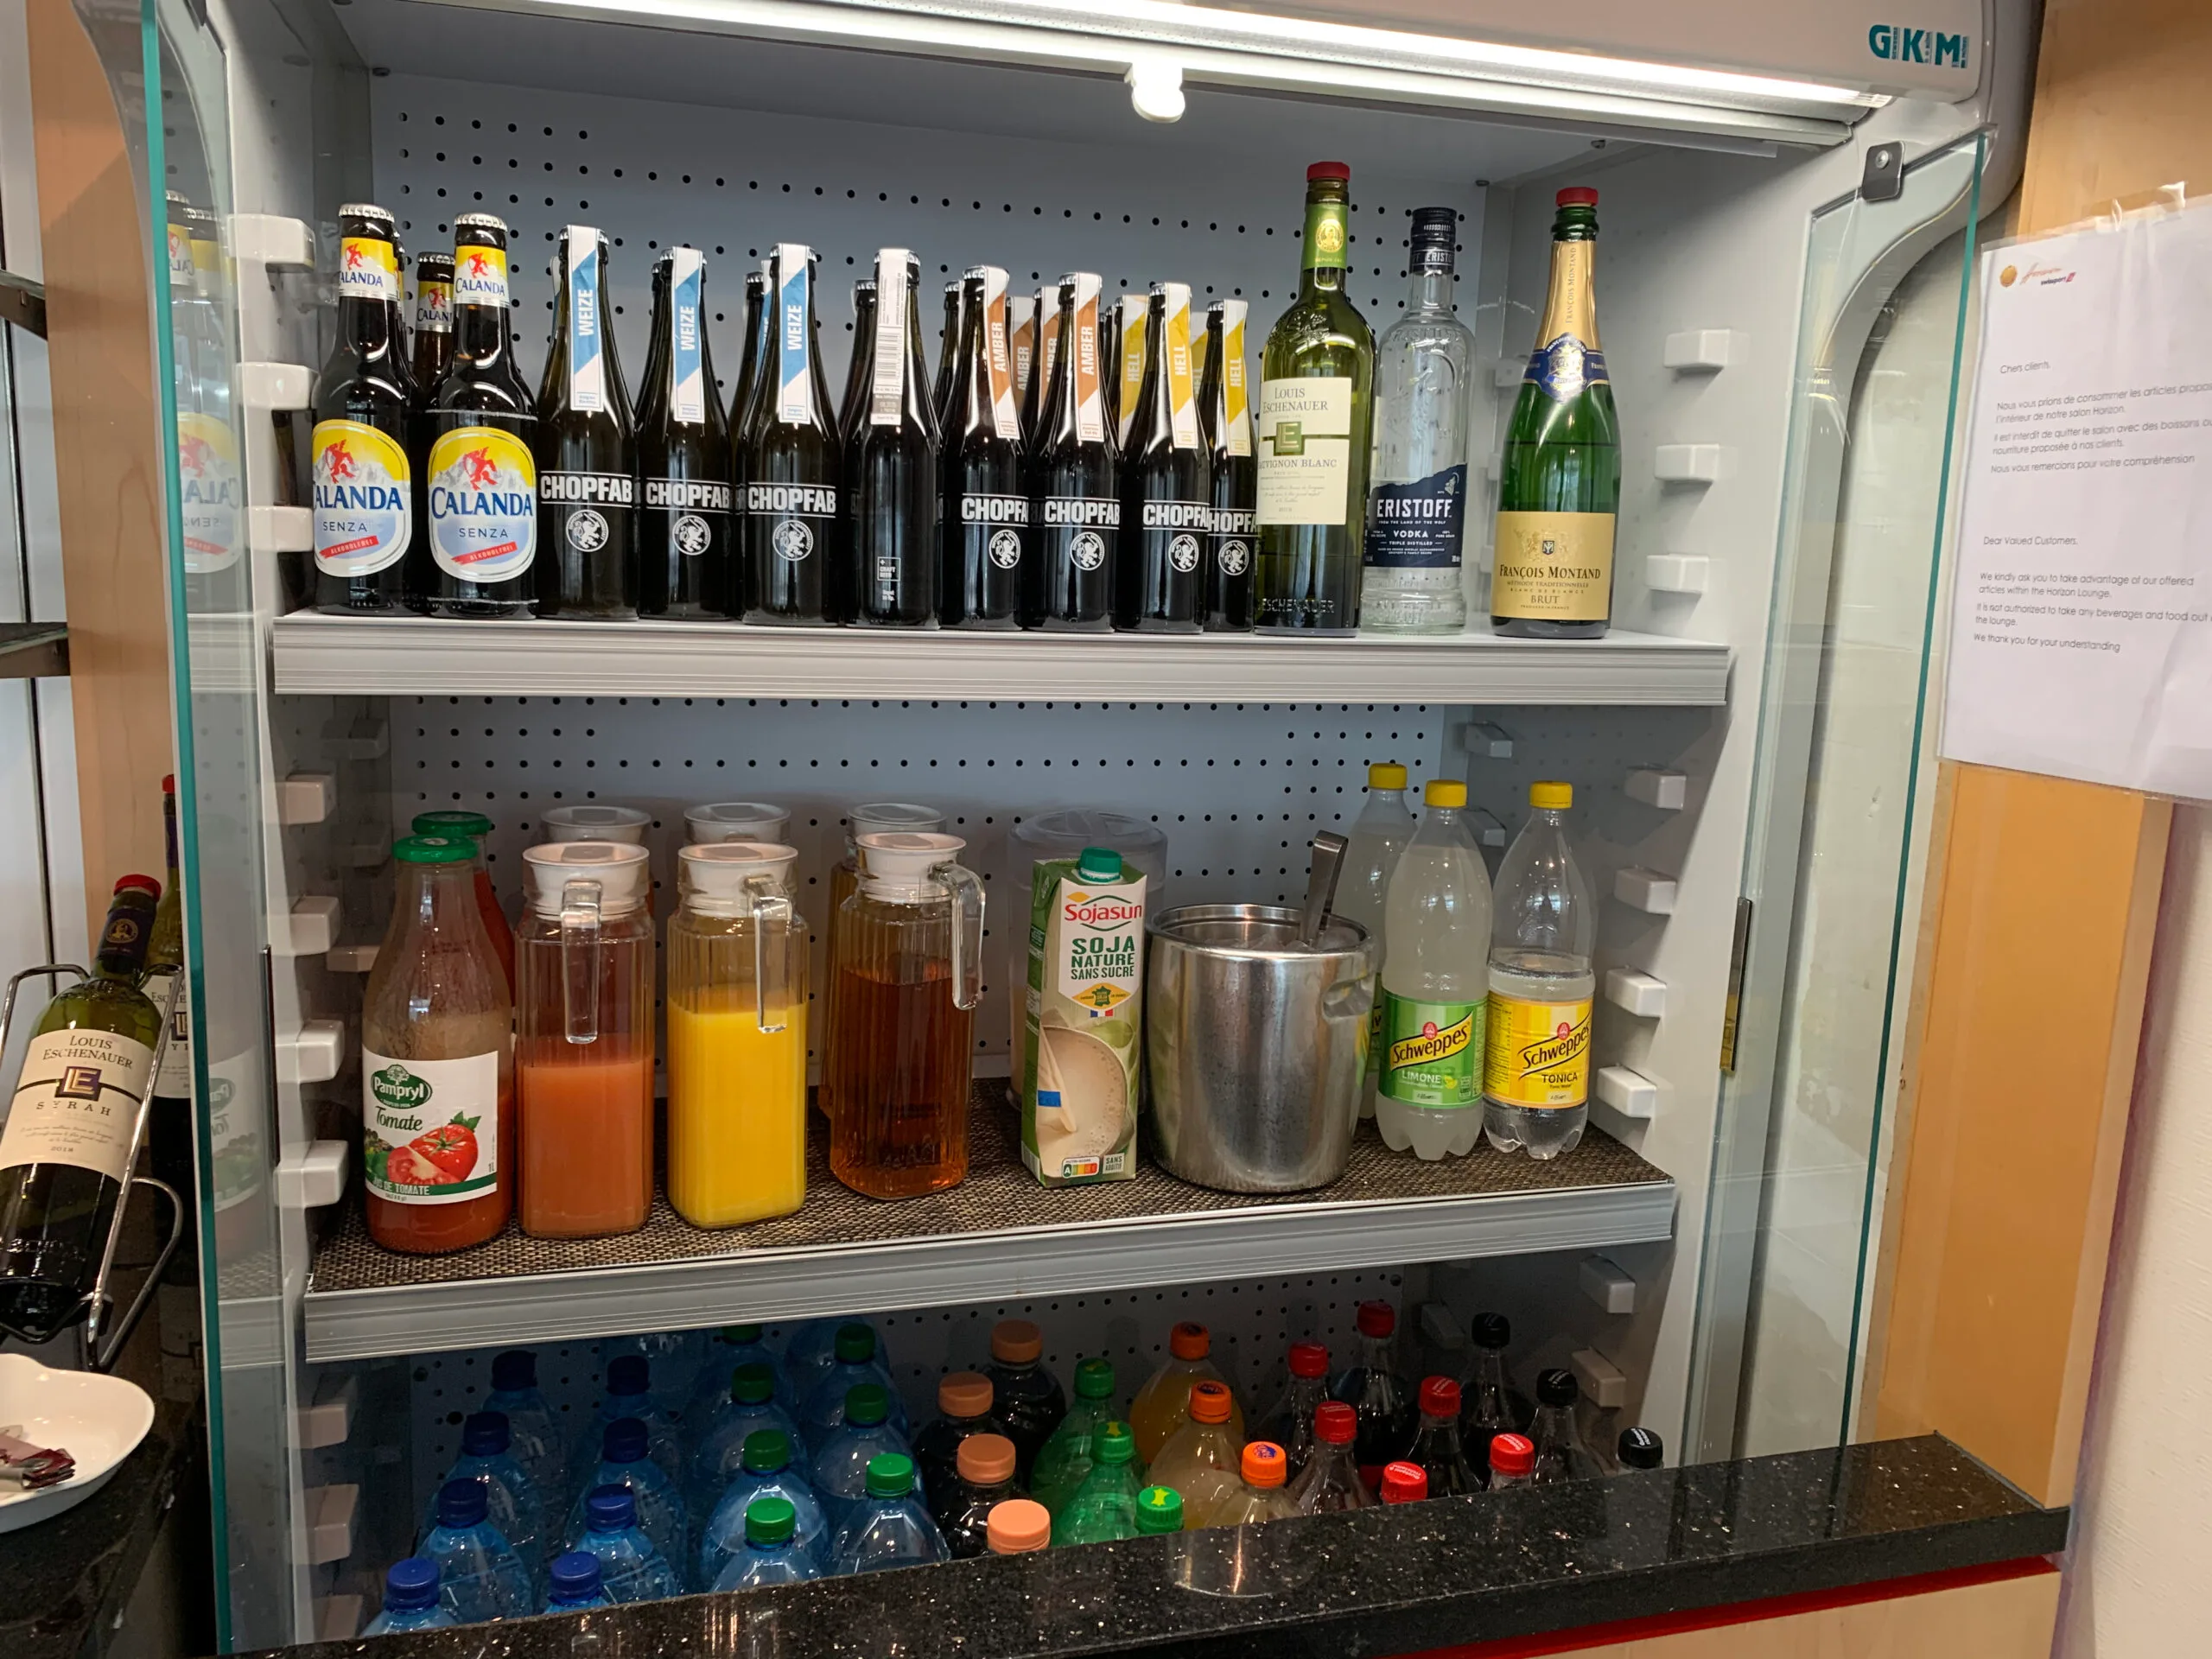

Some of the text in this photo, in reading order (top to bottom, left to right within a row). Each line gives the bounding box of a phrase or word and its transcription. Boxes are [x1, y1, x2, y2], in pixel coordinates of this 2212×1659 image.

[1869, 24, 1961, 67] GKM
[340, 270, 384, 288] ALANDA
[455, 277, 505, 296] CALANDA
[416, 308, 452, 322] CALAN
[577, 289, 594, 337] WEIZE
[679, 305, 696, 351] WEIZE
[787, 304, 803, 350] WEIZE
[991, 321, 1006, 372] AMBER
[1080, 326, 1095, 376] AMBER
[1017, 346, 1030, 390] AMBER
[1127, 352, 1141, 383] HELL
[1173, 344, 1188, 376] HELL
[1999, 364, 2023, 374] Chers
[1230, 357, 1243, 387] HELL
[1274, 387, 1306, 399] LOUIS
[1997, 402, 2016, 410] Nous
[2018, 400, 2037, 409] vous
[2037, 397, 2062, 408] prions
[2063, 395, 2075, 404] de
[2076, 391, 2128, 404] consommer
[2129, 388, 2141, 397] les
[2143, 385, 2177, 397] articles
[1262, 401, 1329, 414] ESCHENAUER
[2032, 412, 2044, 421] de
[2046, 410, 2068, 419] notre
[2069, 408, 2091, 417] salon
[2012, 430, 2040, 441] interdit
[2041, 430, 2052, 439] de
[2054, 428, 2081, 439] quitter
[2082, 427, 2090, 435] le
[2092, 425, 2114, 435] salon
[2116, 423, 2140, 433] avec
[2142, 422, 2158, 431] des
[2160, 419, 2200, 429] boissons
[2031, 442, 2069, 454] proposée
[1300, 459, 1338, 467] BLANC
[1991, 465, 2010, 474] Nous
[2031, 462, 2075, 472] remercions
[2076, 461, 2098, 470] pour
[2100, 459, 2121, 467] votre
[2123, 454, 2196, 467] compréhension
[313, 482, 404, 511] ALANDA
[540, 475, 632, 503] CHOPFAB
[646, 482, 730, 508] CHOPFAB
[432, 486, 533, 519] CALANDA
[748, 486, 836, 513] CHOPFAB
[1376, 499, 1453, 518] ERISTOFF
[962, 497, 1029, 523] CHOPFA
[1045, 500, 1121, 525] CHOPFAB
[322, 521, 368, 532] SENZA
[459, 527, 509, 538] SENZA
[1393, 530, 1429, 538] VODKA
[1983, 536, 2002, 545] Dear
[2005, 537, 2033, 545] Valued
[1499, 564, 1601, 580] FRANÇOIS MONTAND
[1994, 573, 2016, 582] kindly
[2018, 573, 2031, 582] ask
[2032, 575, 2047, 583] you
[2050, 574, 2057, 582] to
[2059, 574, 2078, 582] take
[2079, 575, 2129, 586] advantage
[2131, 575, 2141, 584] of
[2158, 575, 2195, 586] offered
[1530, 594, 1560, 604] BRUT
[1979, 586, 2005, 594] articles
[2007, 586, 2029, 594] within
[2031, 587, 2044, 595] the
[2046, 588, 2075, 596] Horizon
[1975, 615, 1988, 624] the
[2004, 604, 2046, 614] authorized
[2048, 606, 2056, 614] to
[2058, 607, 2076, 616] take
[2078, 608, 2094, 617] any
[2096, 608, 2143, 620] beverages
[2145, 611, 2164, 620] and
[2165, 611, 2189, 621] food
[2190, 613, 2208, 622] out
[1974, 633, 2120, 653] We thank you for your understanding
[1064, 903, 1142, 925] Sojasun
[1071, 936, 1135, 955] SOJA
[1071, 952, 1135, 968] NATURE
[1071, 965, 1135, 980] SANS SUCRE
[70, 1035, 112, 1049] LOUIS
[1393, 1024, 1468, 1064] Schweppes
[1522, 1020, 1590, 1070] Schweppes
[43, 1048, 133, 1069] ESCHENAUER
[1402, 1069, 1442, 1084] LIMONE
[1541, 1071, 1578, 1084] TONICA
[373, 1077, 424, 1101] Pampryl
[375, 1105, 423, 1131] Tomate
[1106, 1155, 1122, 1165] SANS
[395, 1183, 430, 1195] TOMATE
